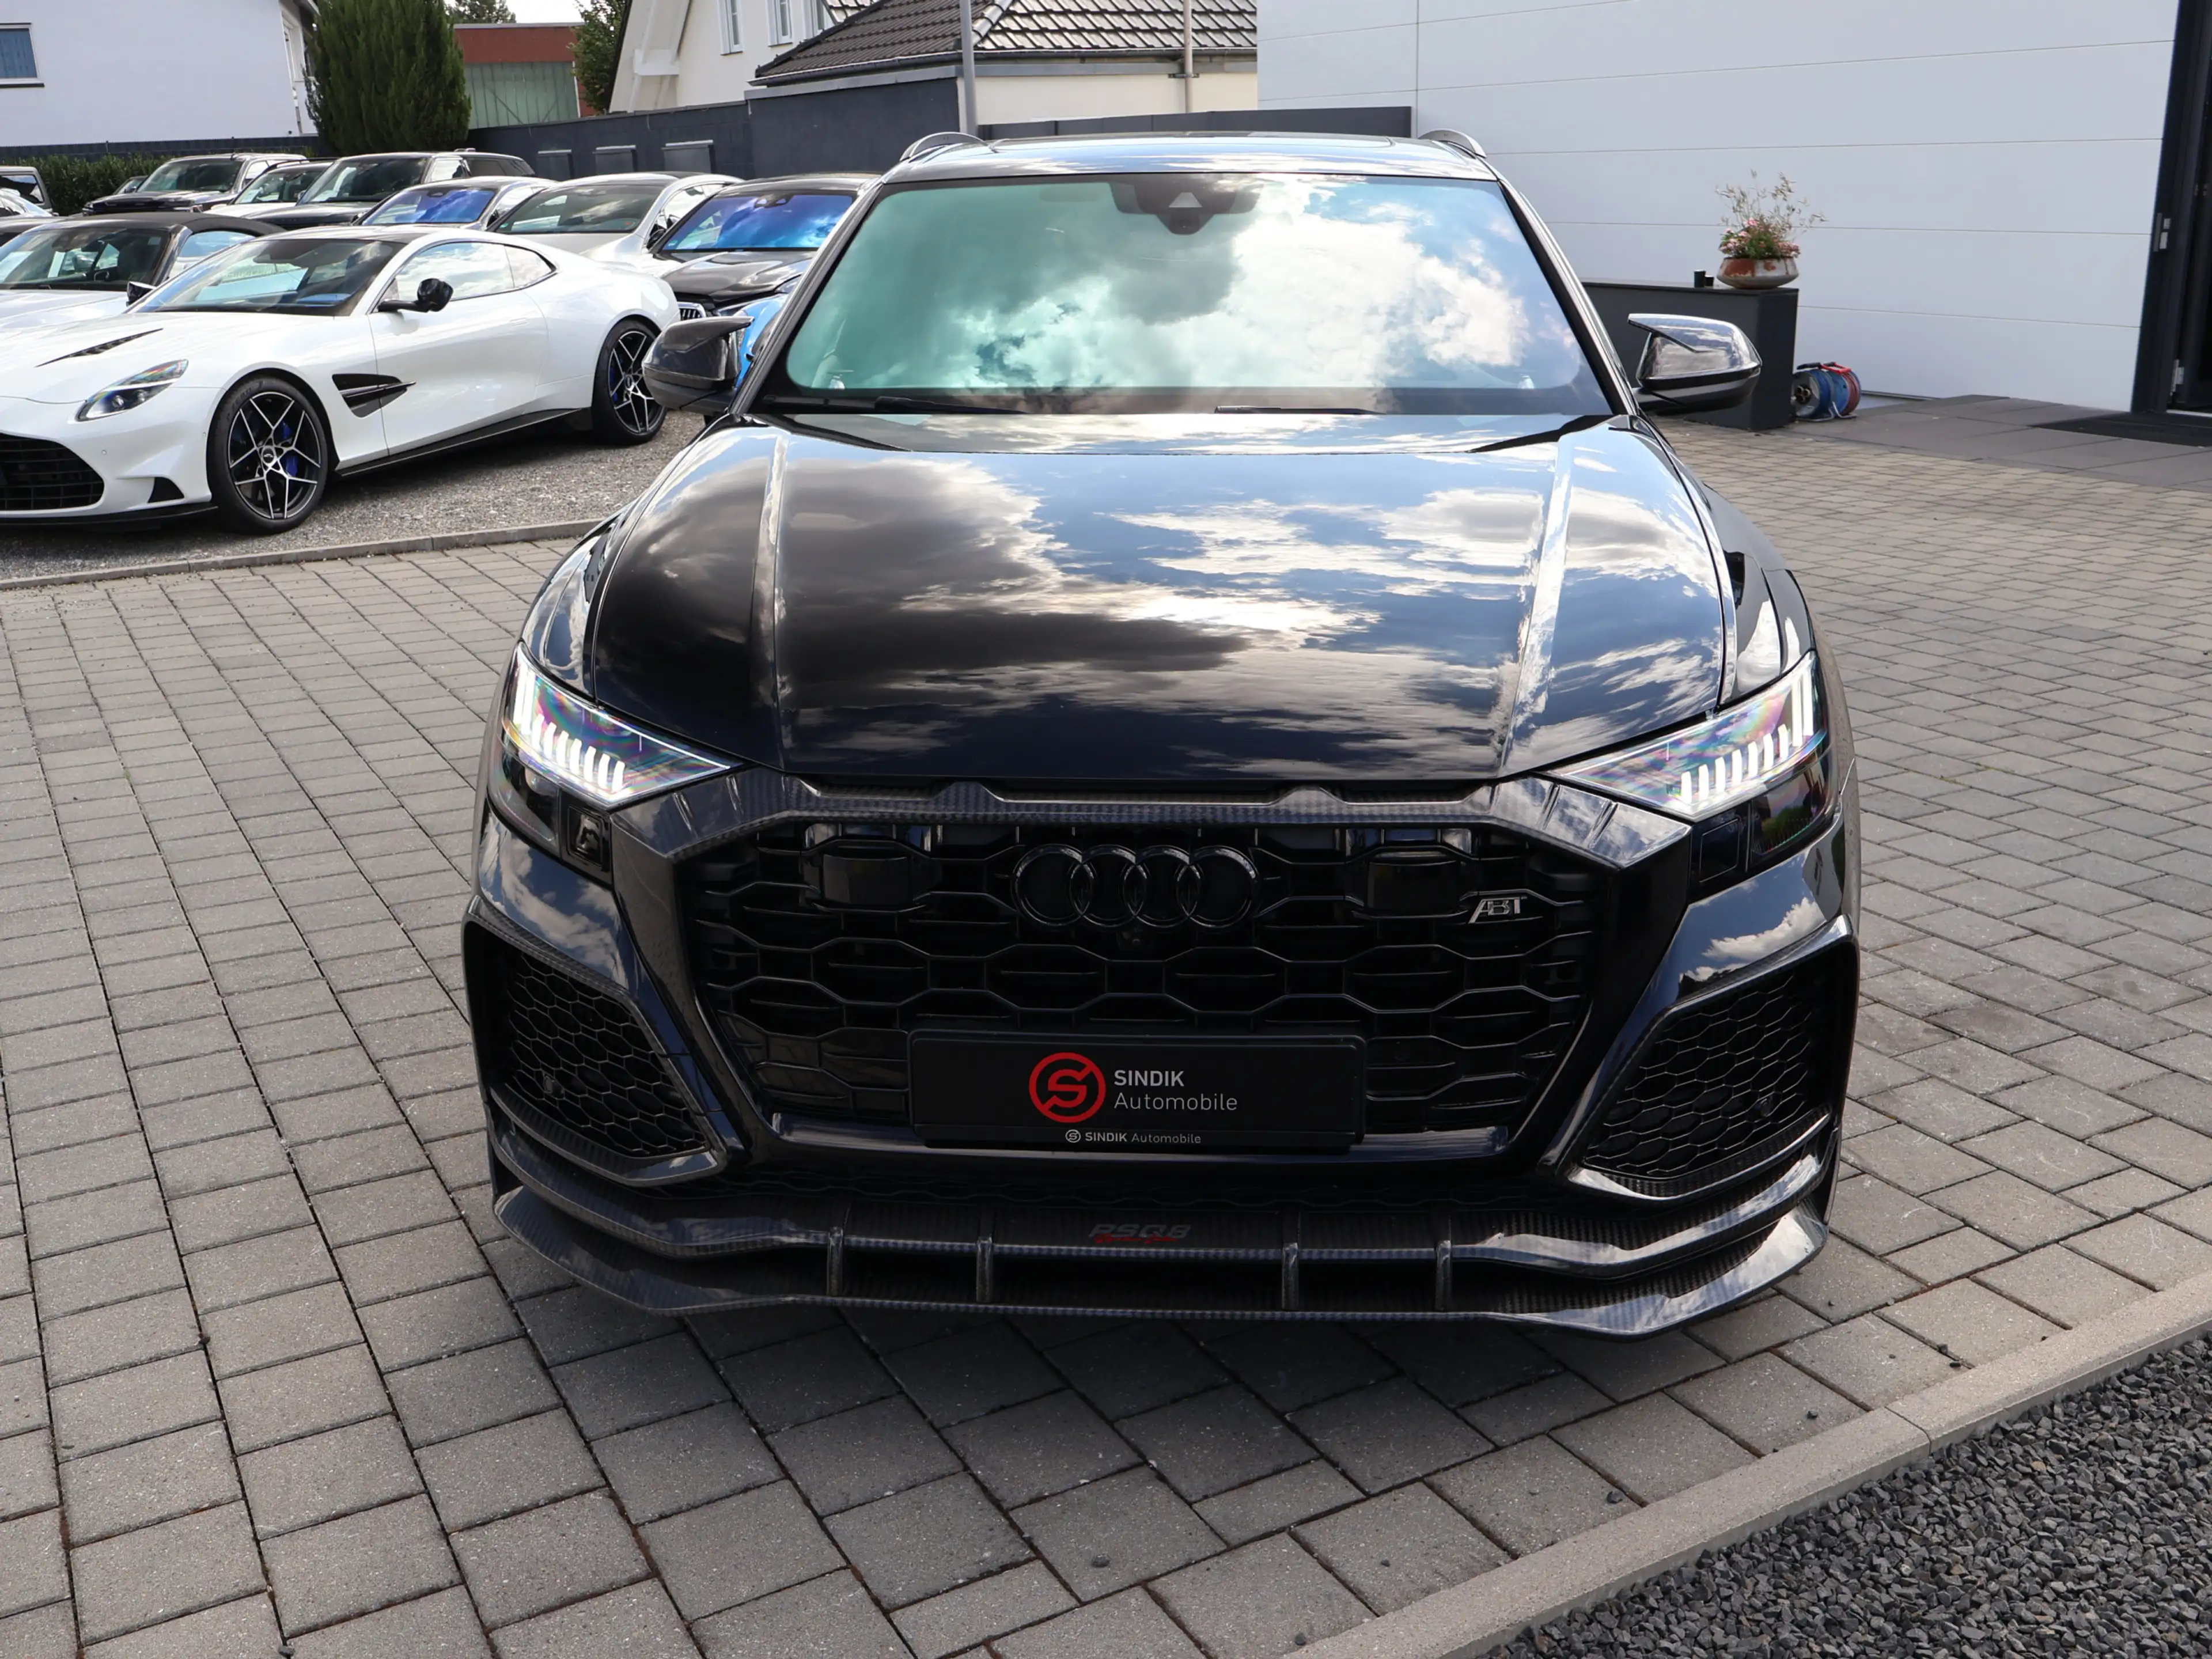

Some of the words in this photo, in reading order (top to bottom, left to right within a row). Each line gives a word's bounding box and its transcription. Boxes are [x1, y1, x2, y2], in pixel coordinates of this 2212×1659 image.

[1468, 896, 1528, 923] ABT
[1114, 1070, 1184, 1086] SINDIK
[1114, 1092, 1237, 1111] Automobile
[1085, 1132, 1127, 1142] SINDIK
[1131, 1132, 1201, 1143] Automobile
